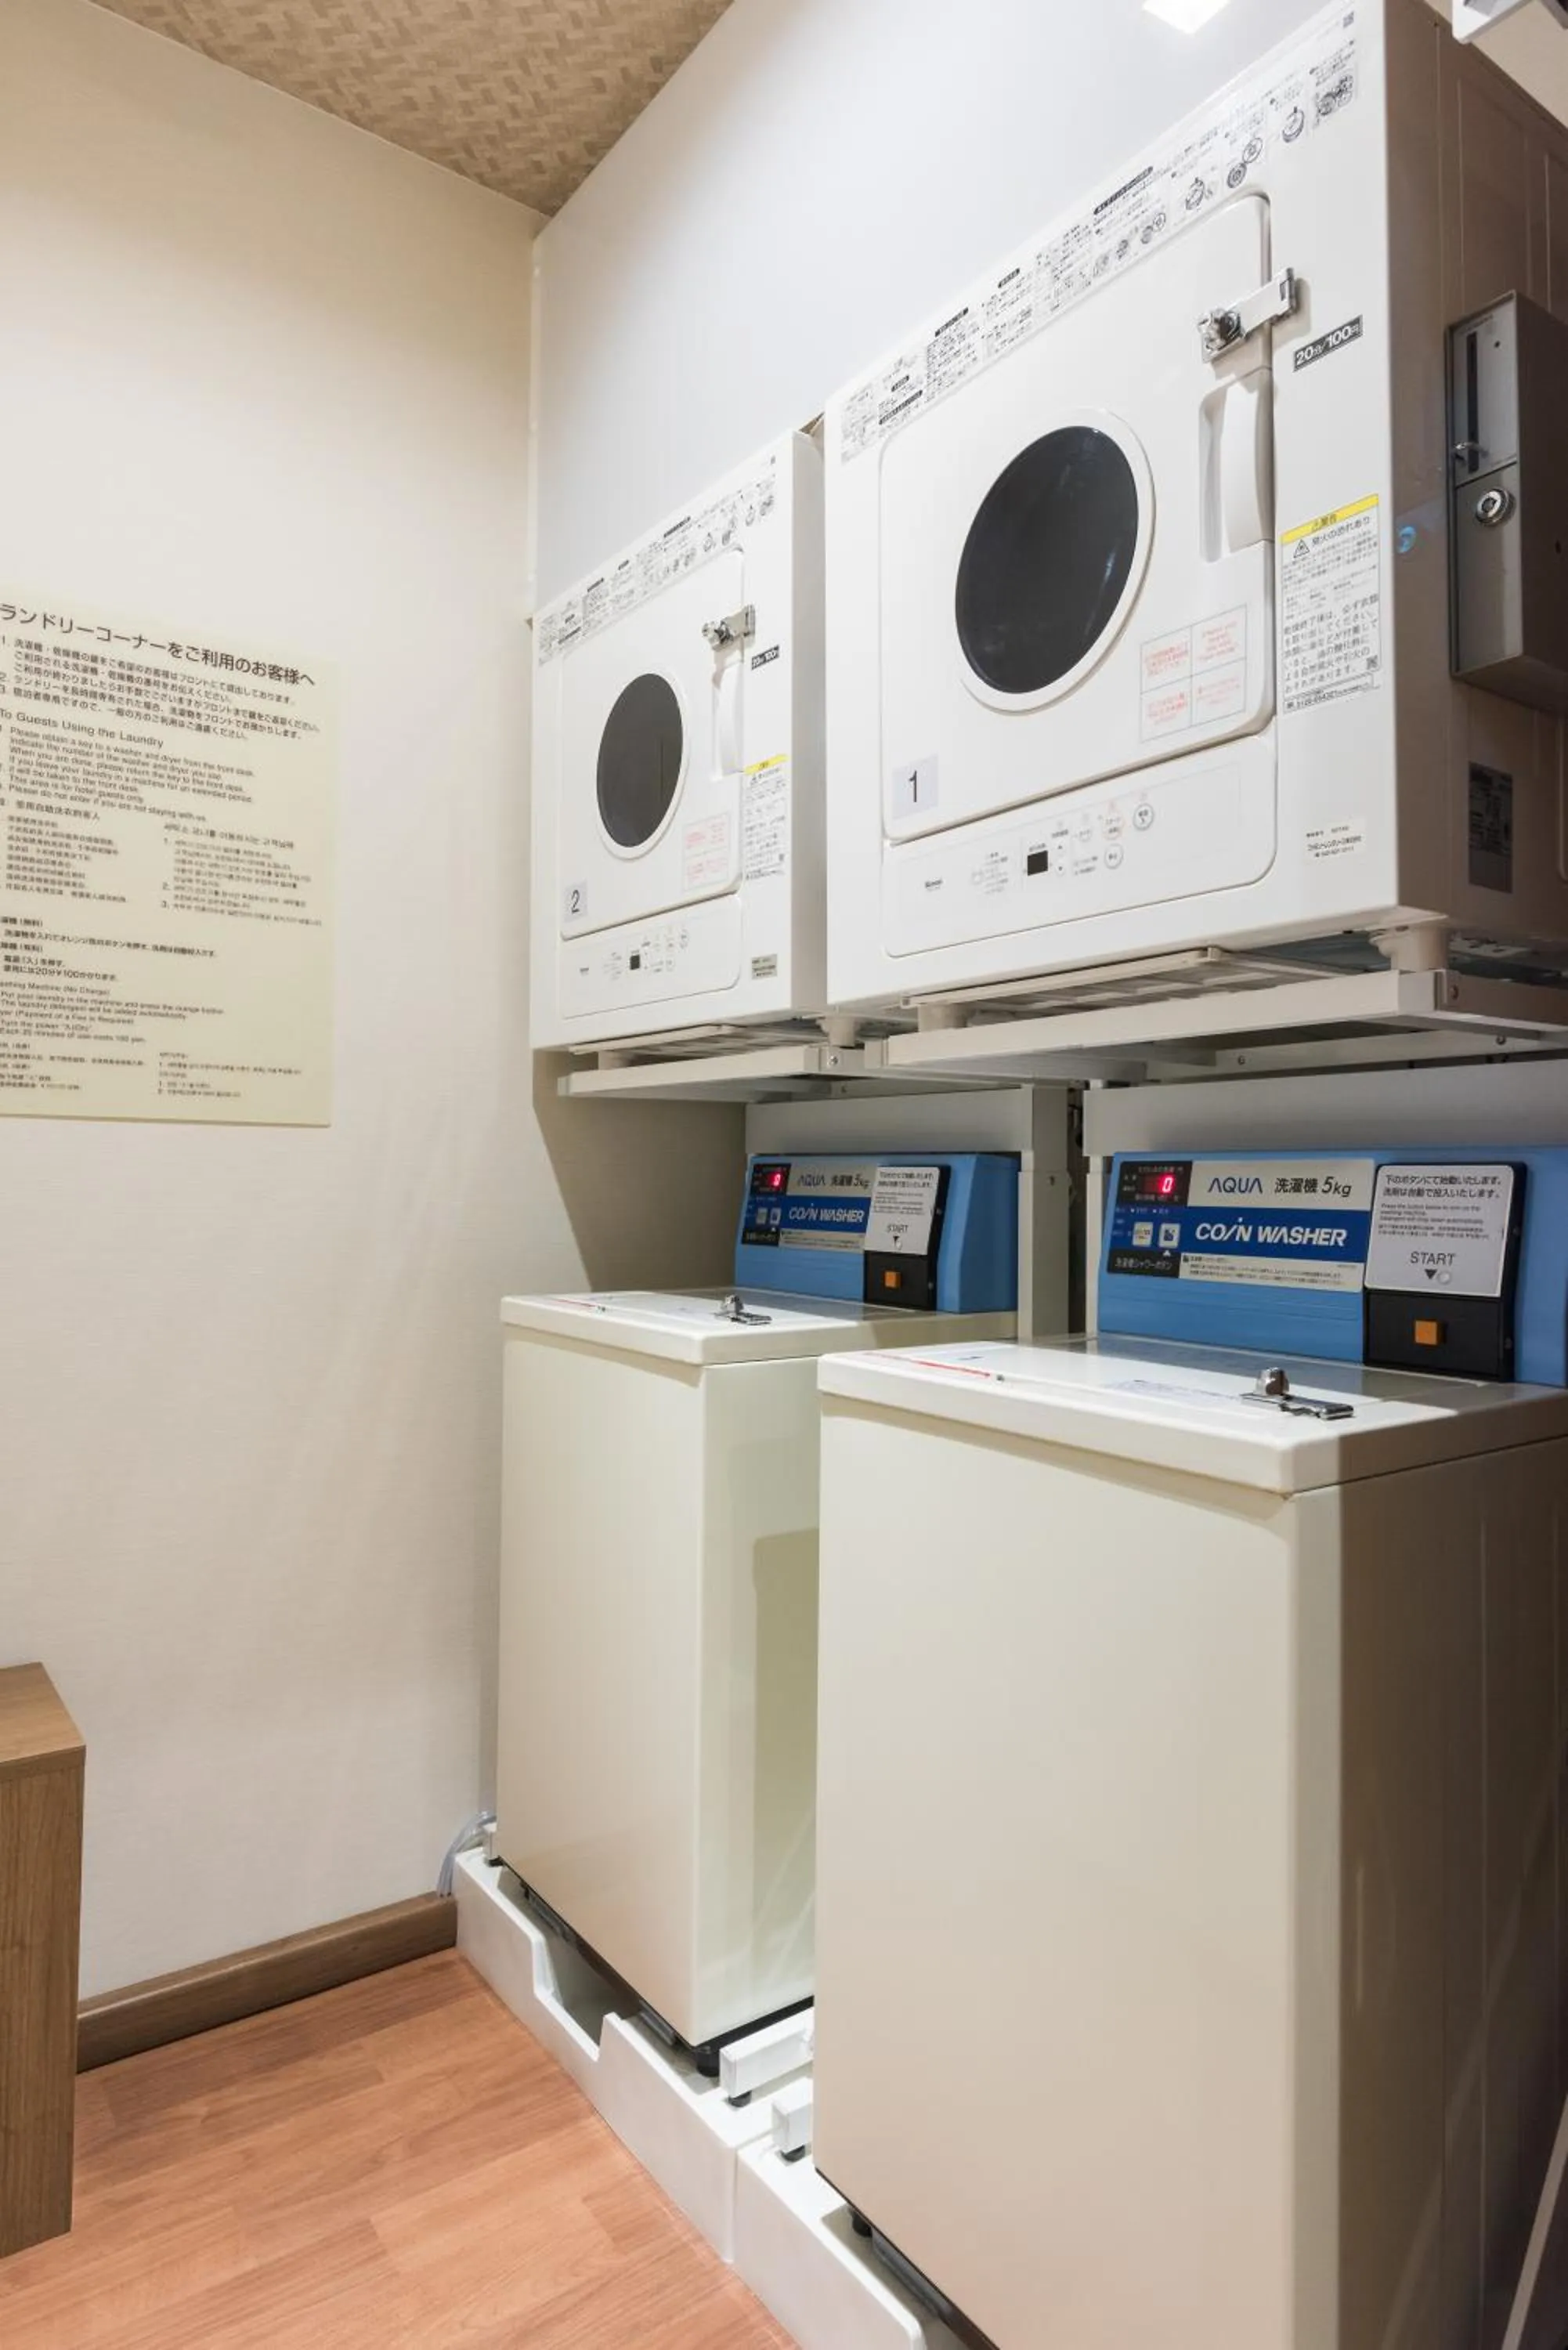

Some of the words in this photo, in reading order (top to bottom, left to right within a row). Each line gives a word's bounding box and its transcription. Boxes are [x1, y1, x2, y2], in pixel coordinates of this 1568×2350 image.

[0, 605, 315, 684] ランドリーコーナーをご利用のお客様へ
[0, 707, 13, 719] To
[16, 711, 58, 727] Guests
[62, 720, 95, 736] Using
[97, 728, 115, 738] the
[119, 731, 163, 749] Laundry
[908, 769, 918, 803] 1
[571, 889, 580, 914] 2
[1162, 1176, 1174, 1193] 0
[1207, 1177, 1263, 1194] AQUA
[1274, 1177, 1319, 1194] 洗濯機
[1321, 1176, 1353, 1198] 5kg
[819, 1209, 865, 1224] WASHER
[1257, 1225, 1348, 1247] WASHER
[1410, 1251, 1457, 1267] START
